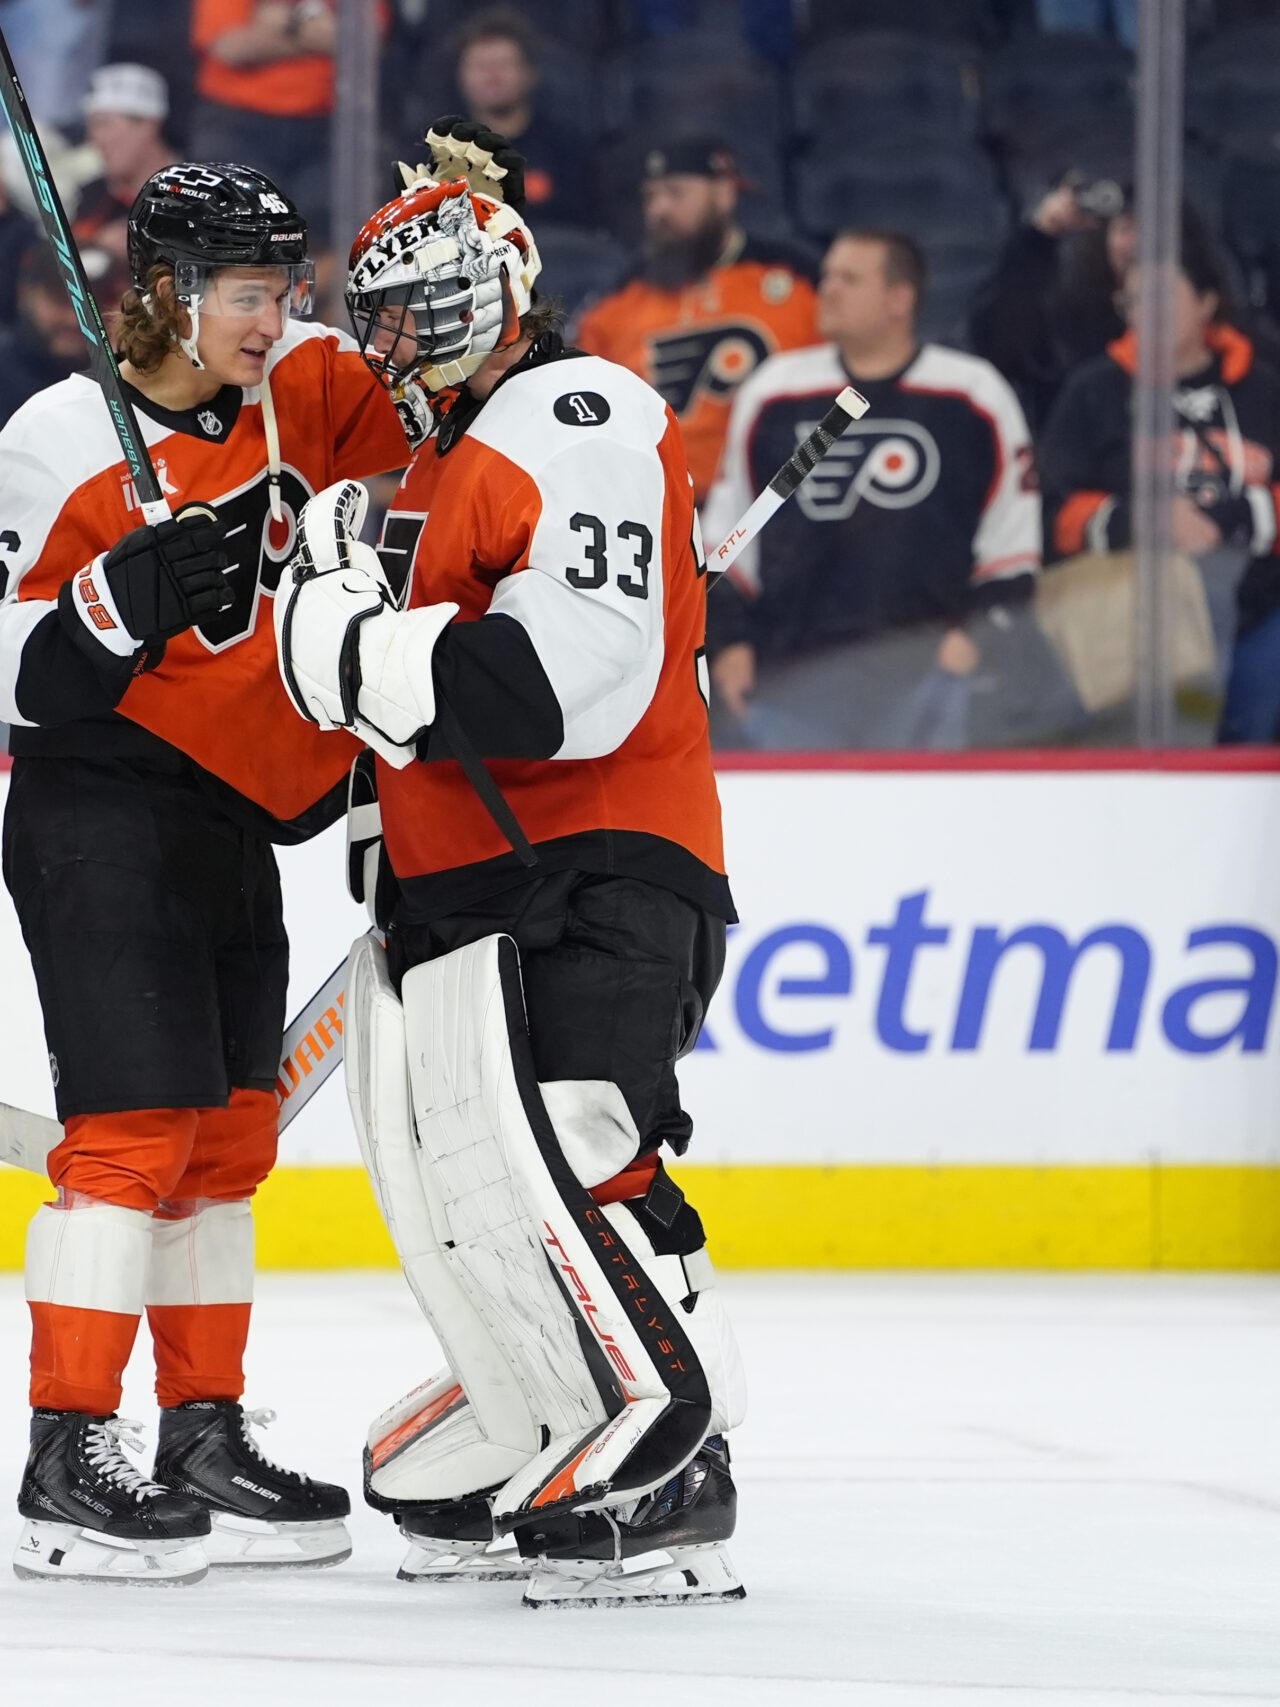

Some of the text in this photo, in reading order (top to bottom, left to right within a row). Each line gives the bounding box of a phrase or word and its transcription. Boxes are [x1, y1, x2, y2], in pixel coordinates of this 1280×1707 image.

[158, 183, 212, 201] CHEVROLET
[258, 192, 290, 215] 46
[569, 394, 598, 423] 1
[565, 511, 654, 601] 33
[718, 528, 747, 559] RTL
[694, 884, 1279, 1057] etma
[542, 1219, 637, 1382] TRUE
[585, 1209, 686, 1373] CATALYST
